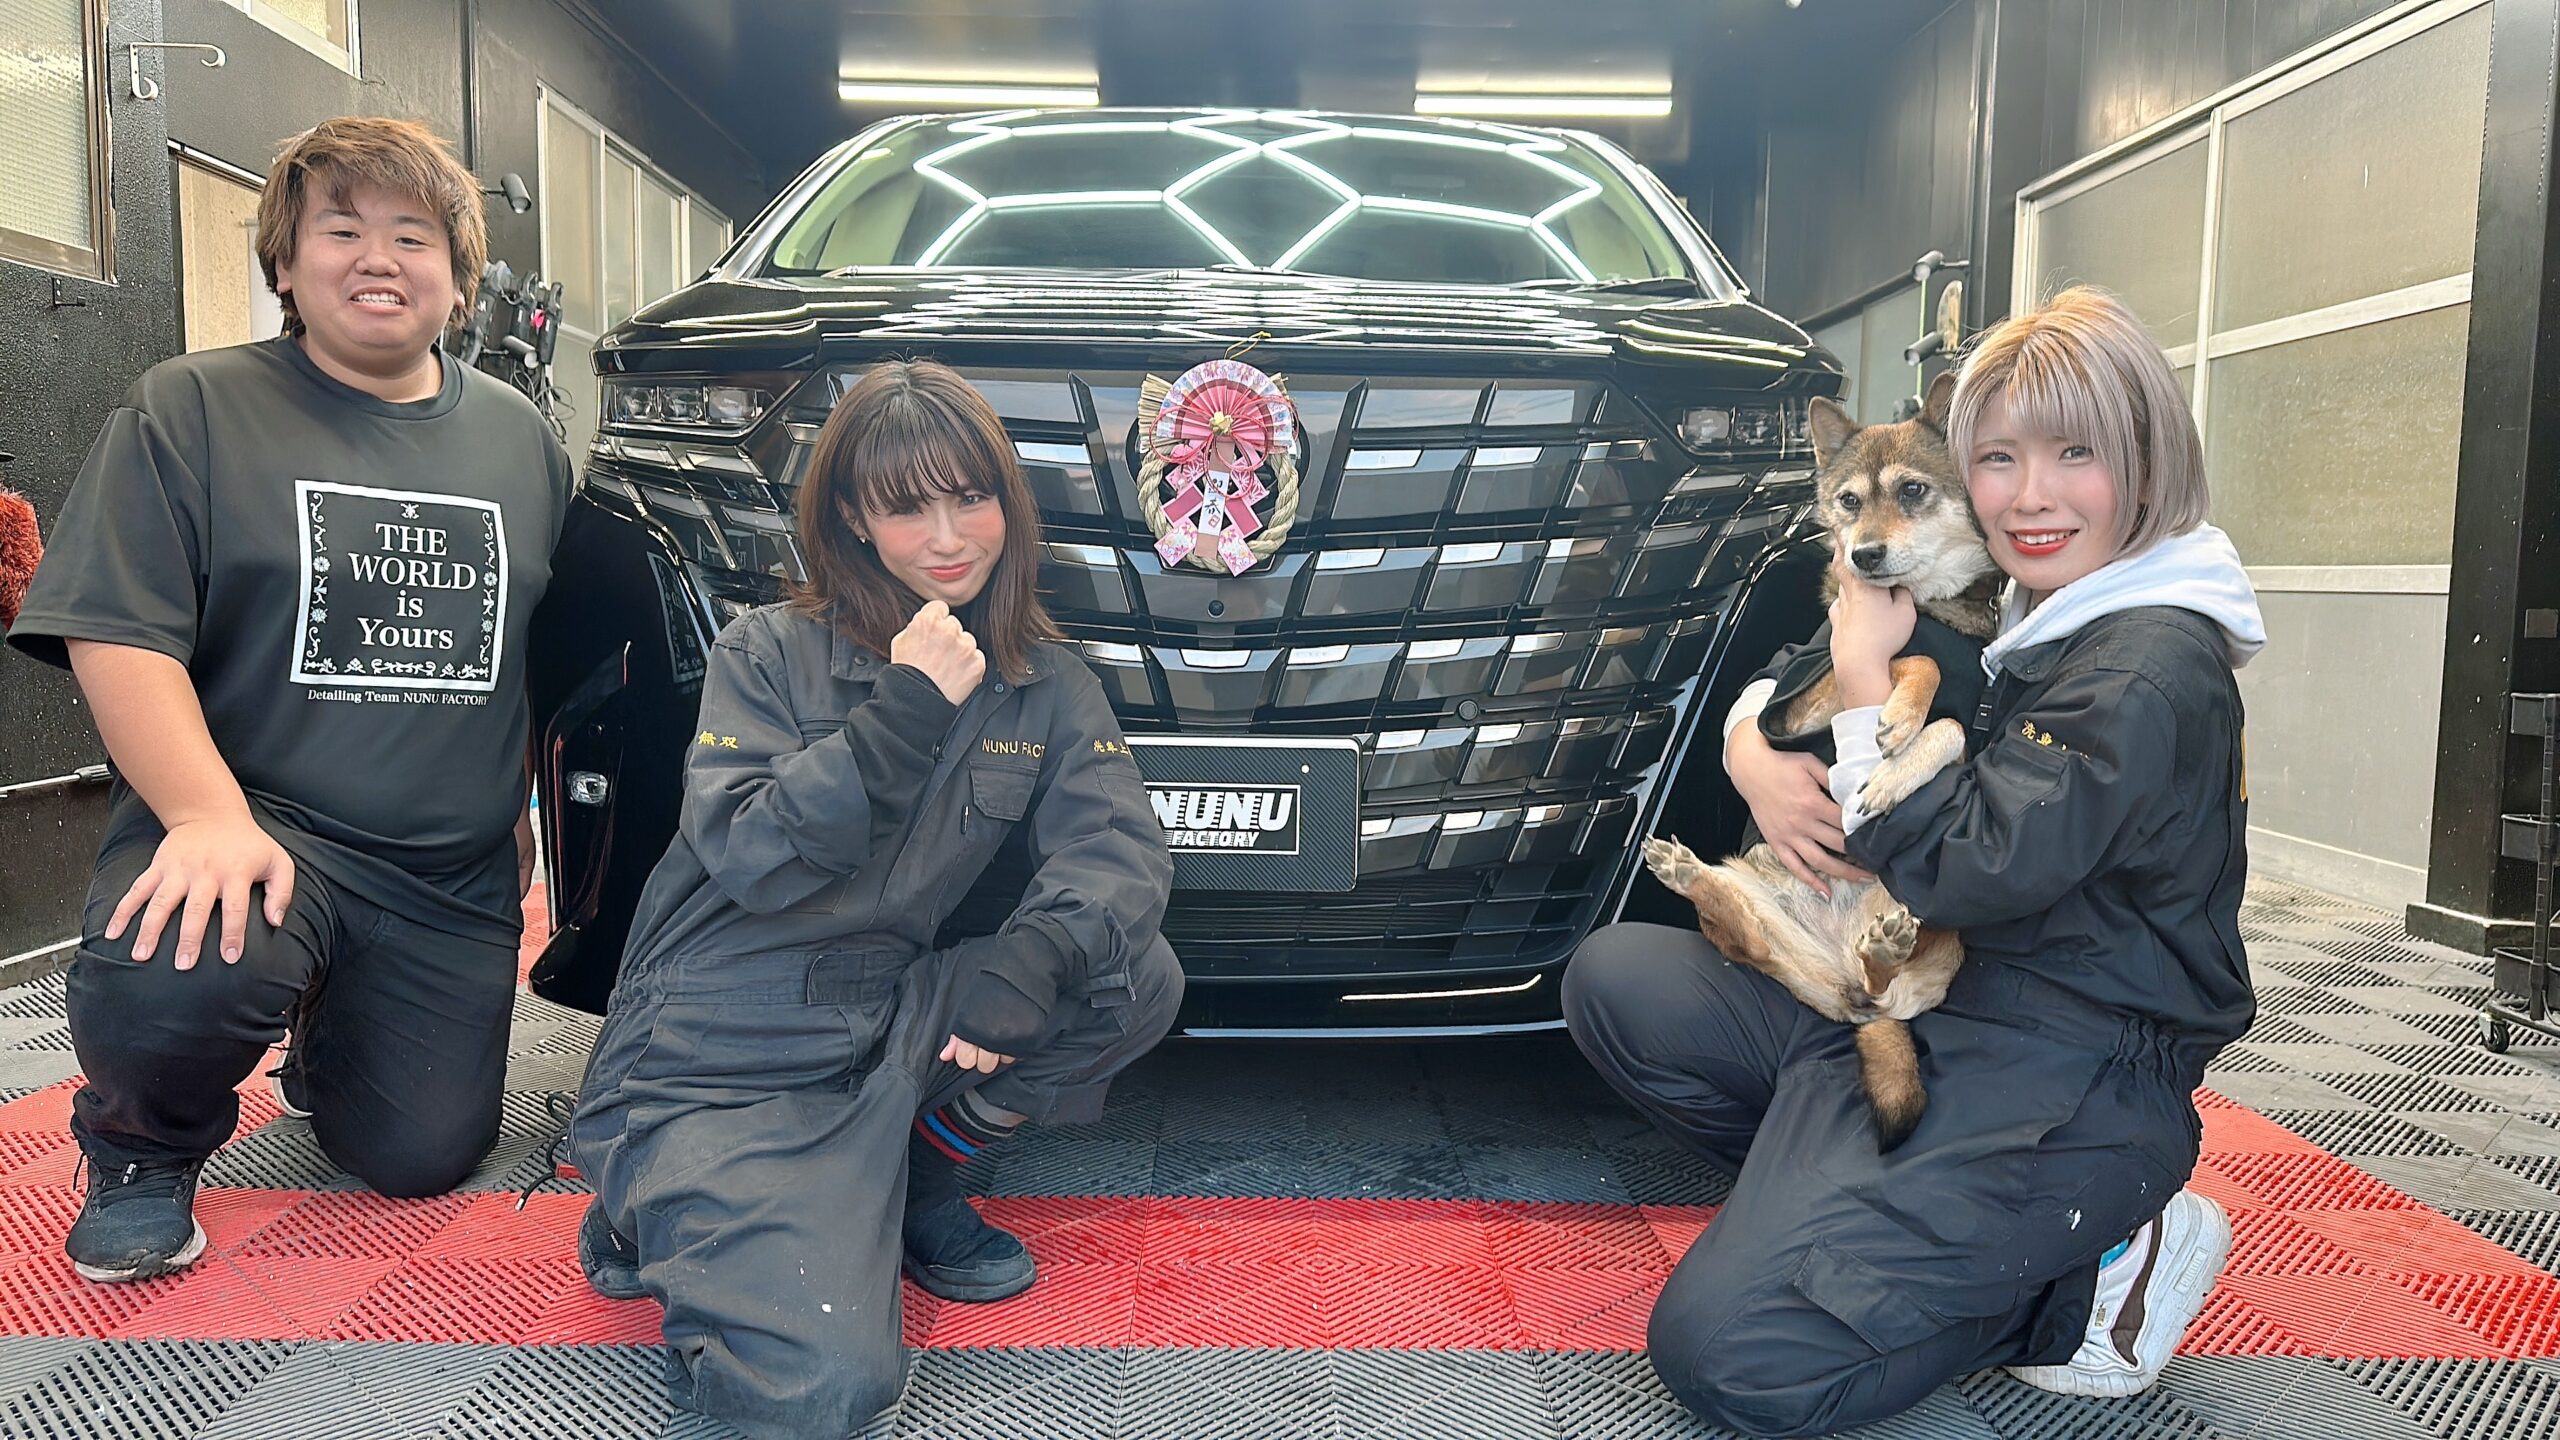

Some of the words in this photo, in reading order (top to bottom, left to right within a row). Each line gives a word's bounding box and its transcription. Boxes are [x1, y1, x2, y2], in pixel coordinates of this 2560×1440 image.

[375, 522, 447, 556] THE
[348, 552, 477, 590] WORLD
[396, 590, 424, 618] is
[357, 617, 454, 650] Yours
[307, 689, 361, 703] Detailing
[365, 691, 400, 703] Team
[403, 692, 439, 704] NUNU
[442, 693, 490, 706] FACTORY
[697, 730, 739, 750] 無双
[982, 737, 1019, 754] NUNU
[1093, 739, 1133, 759] 洗車上
[1147, 790, 1294, 832] NUNU
[1171, 830, 1260, 848] FACTORY
